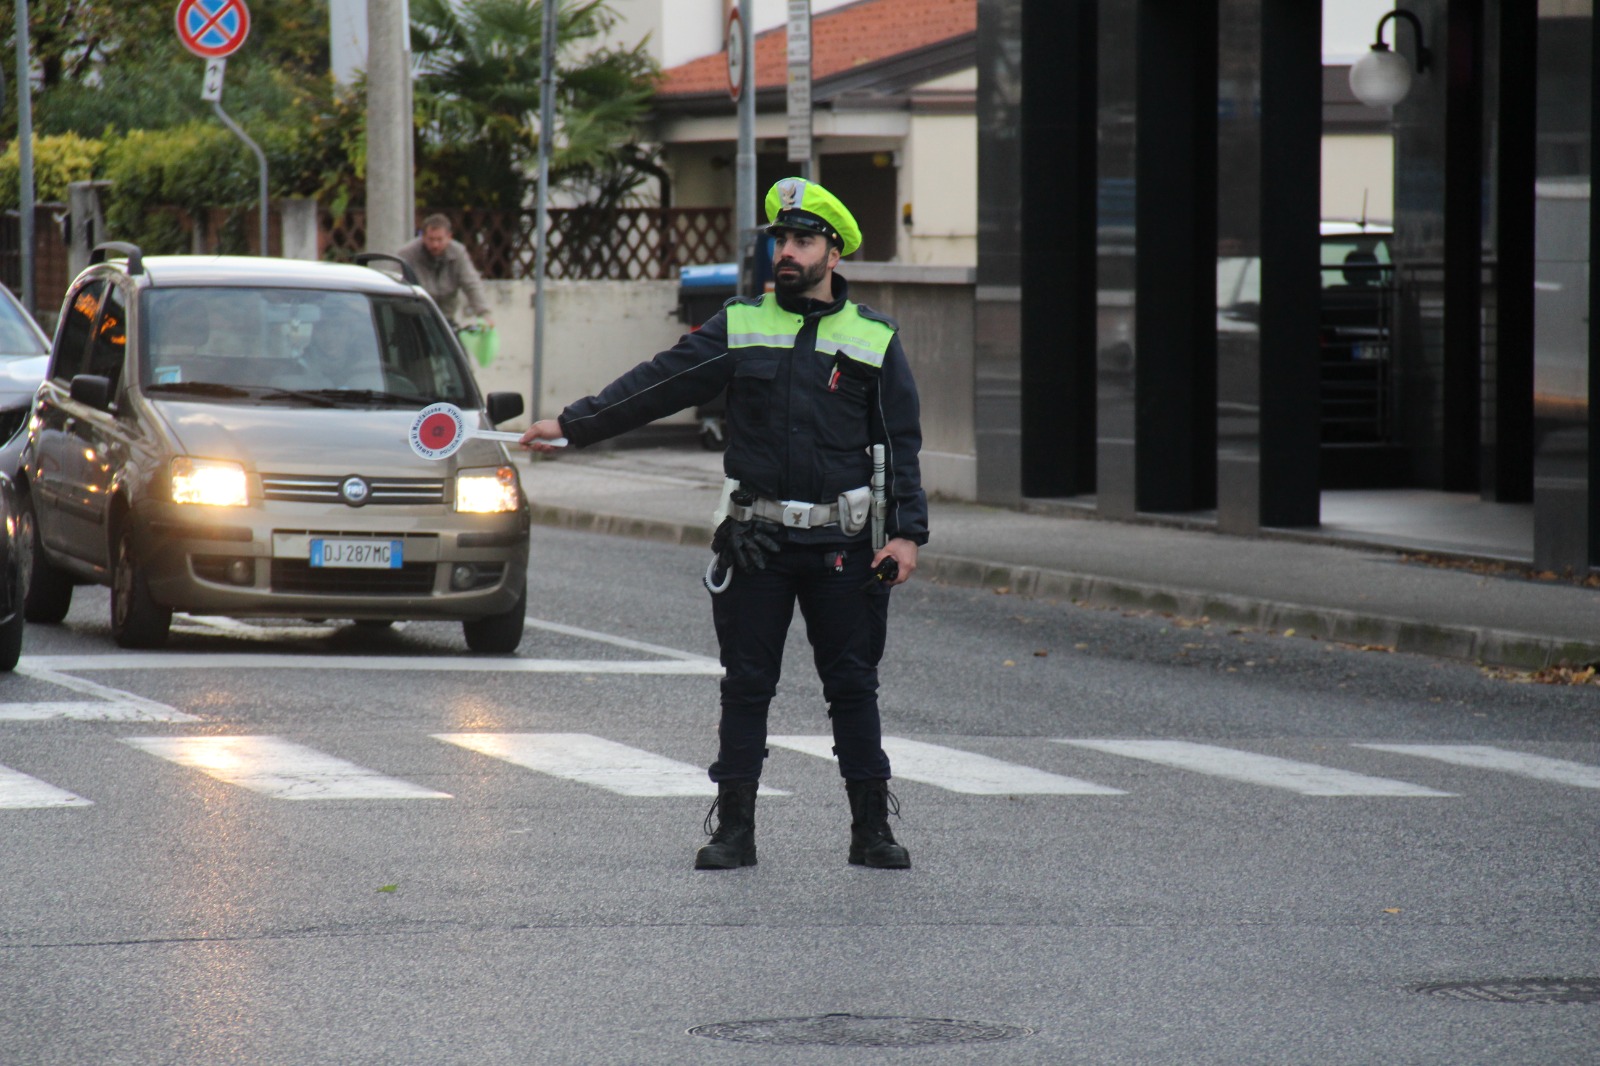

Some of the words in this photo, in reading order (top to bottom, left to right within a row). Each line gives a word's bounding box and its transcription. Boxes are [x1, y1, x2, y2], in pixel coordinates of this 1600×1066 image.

[412, 407, 441, 431] Monfalcone
[446, 408, 463, 438] MUNICIPALE
[414, 440, 433, 457] Comune
[439, 439, 459, 455] POLIZIA
